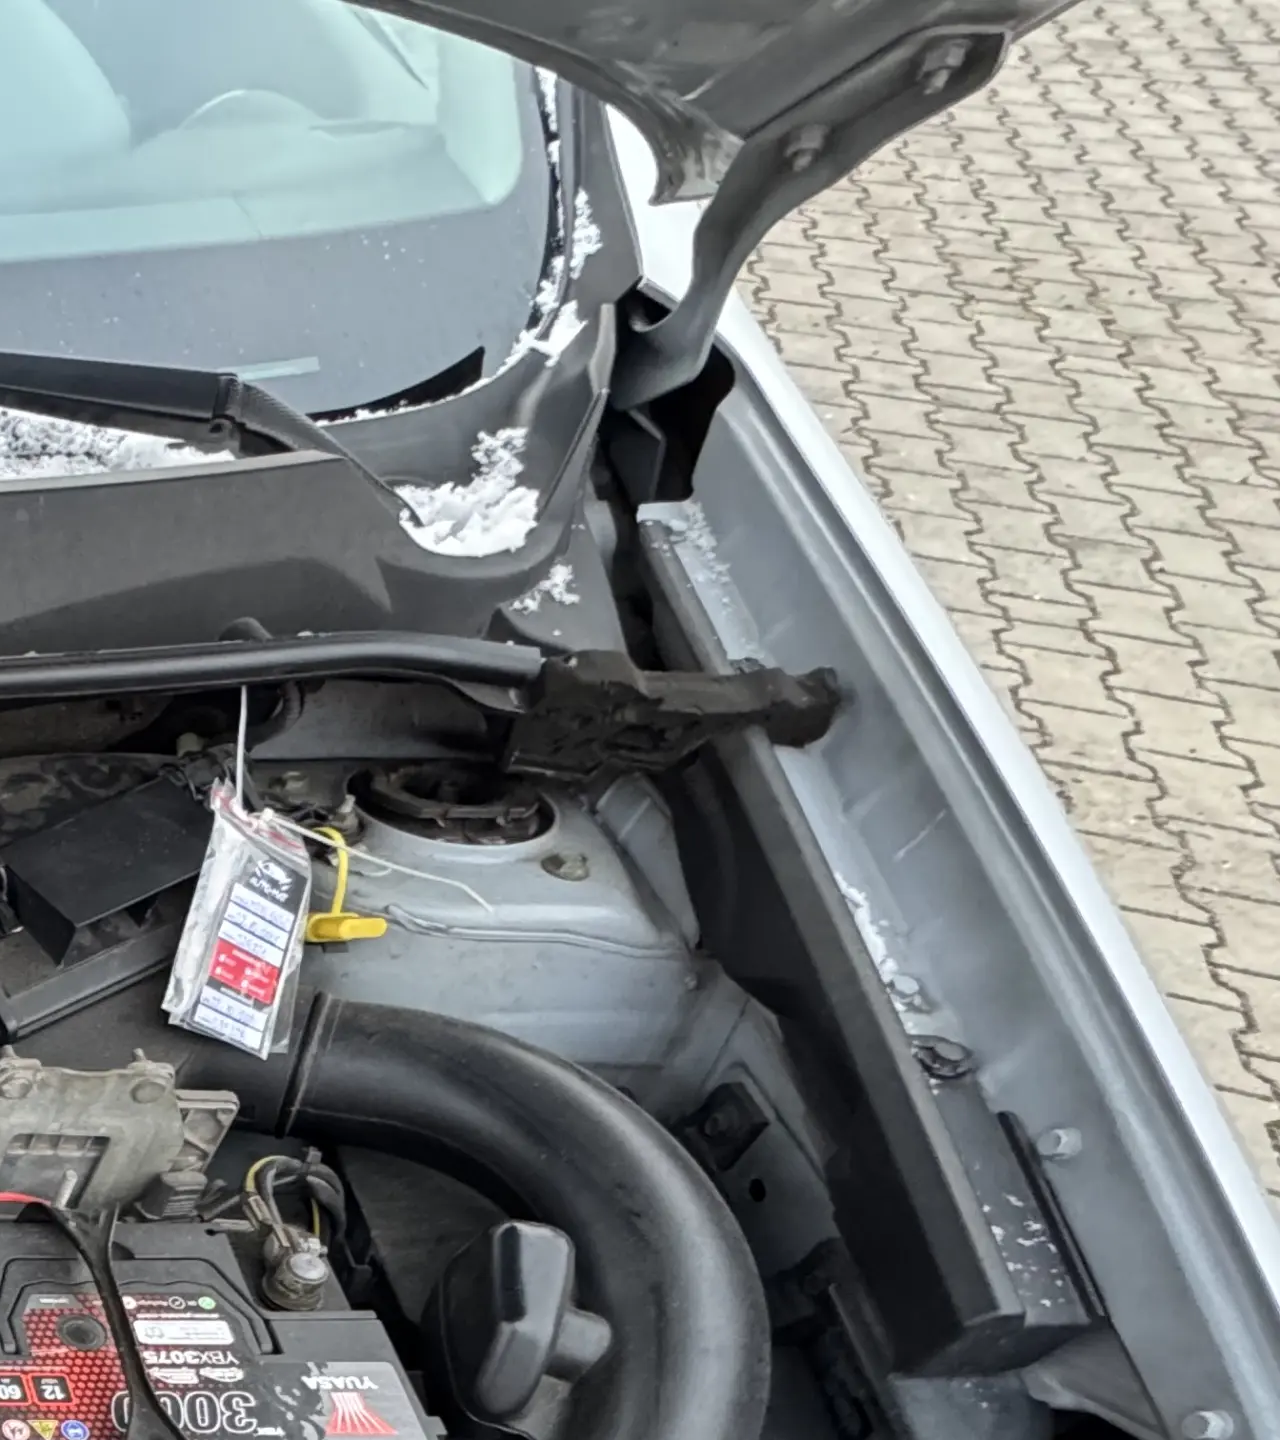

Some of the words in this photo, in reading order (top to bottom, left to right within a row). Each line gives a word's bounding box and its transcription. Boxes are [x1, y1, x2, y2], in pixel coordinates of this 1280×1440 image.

[143, 1350, 241, 1366] YBX3075
[301, 1375, 379, 1391] YUASA
[40, 1385, 65, 1400] 12
